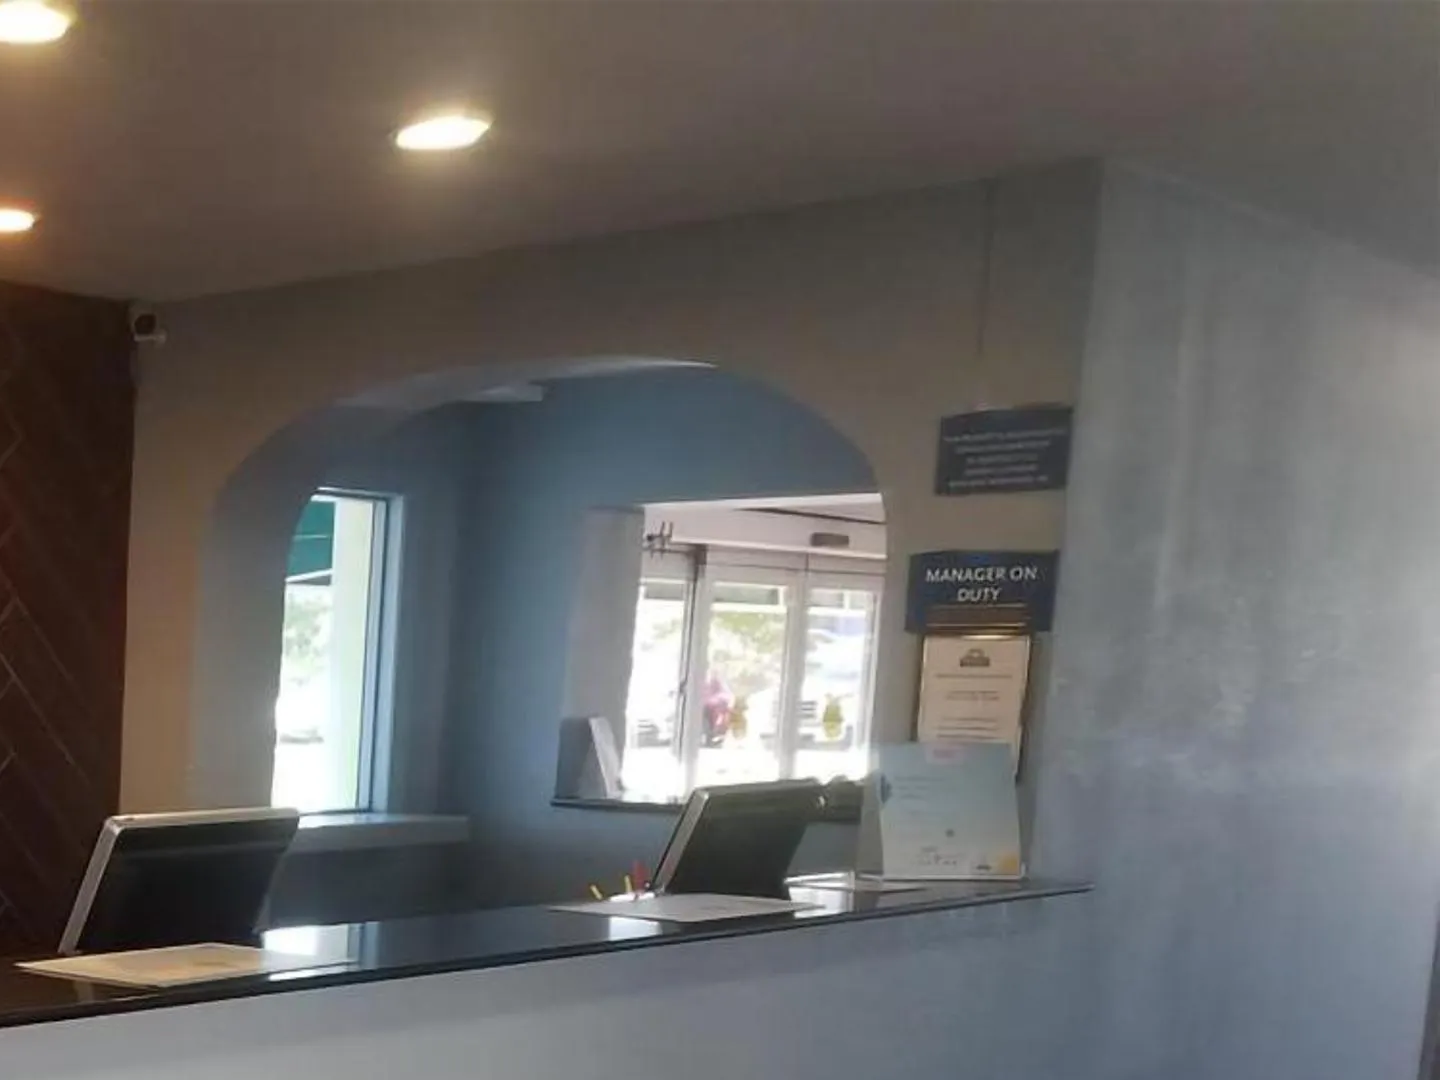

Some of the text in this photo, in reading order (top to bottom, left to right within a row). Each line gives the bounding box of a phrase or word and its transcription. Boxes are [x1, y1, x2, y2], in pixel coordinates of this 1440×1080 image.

[926, 566, 1038, 582] MANAGER ON
[958, 587, 1001, 602] DUTY
